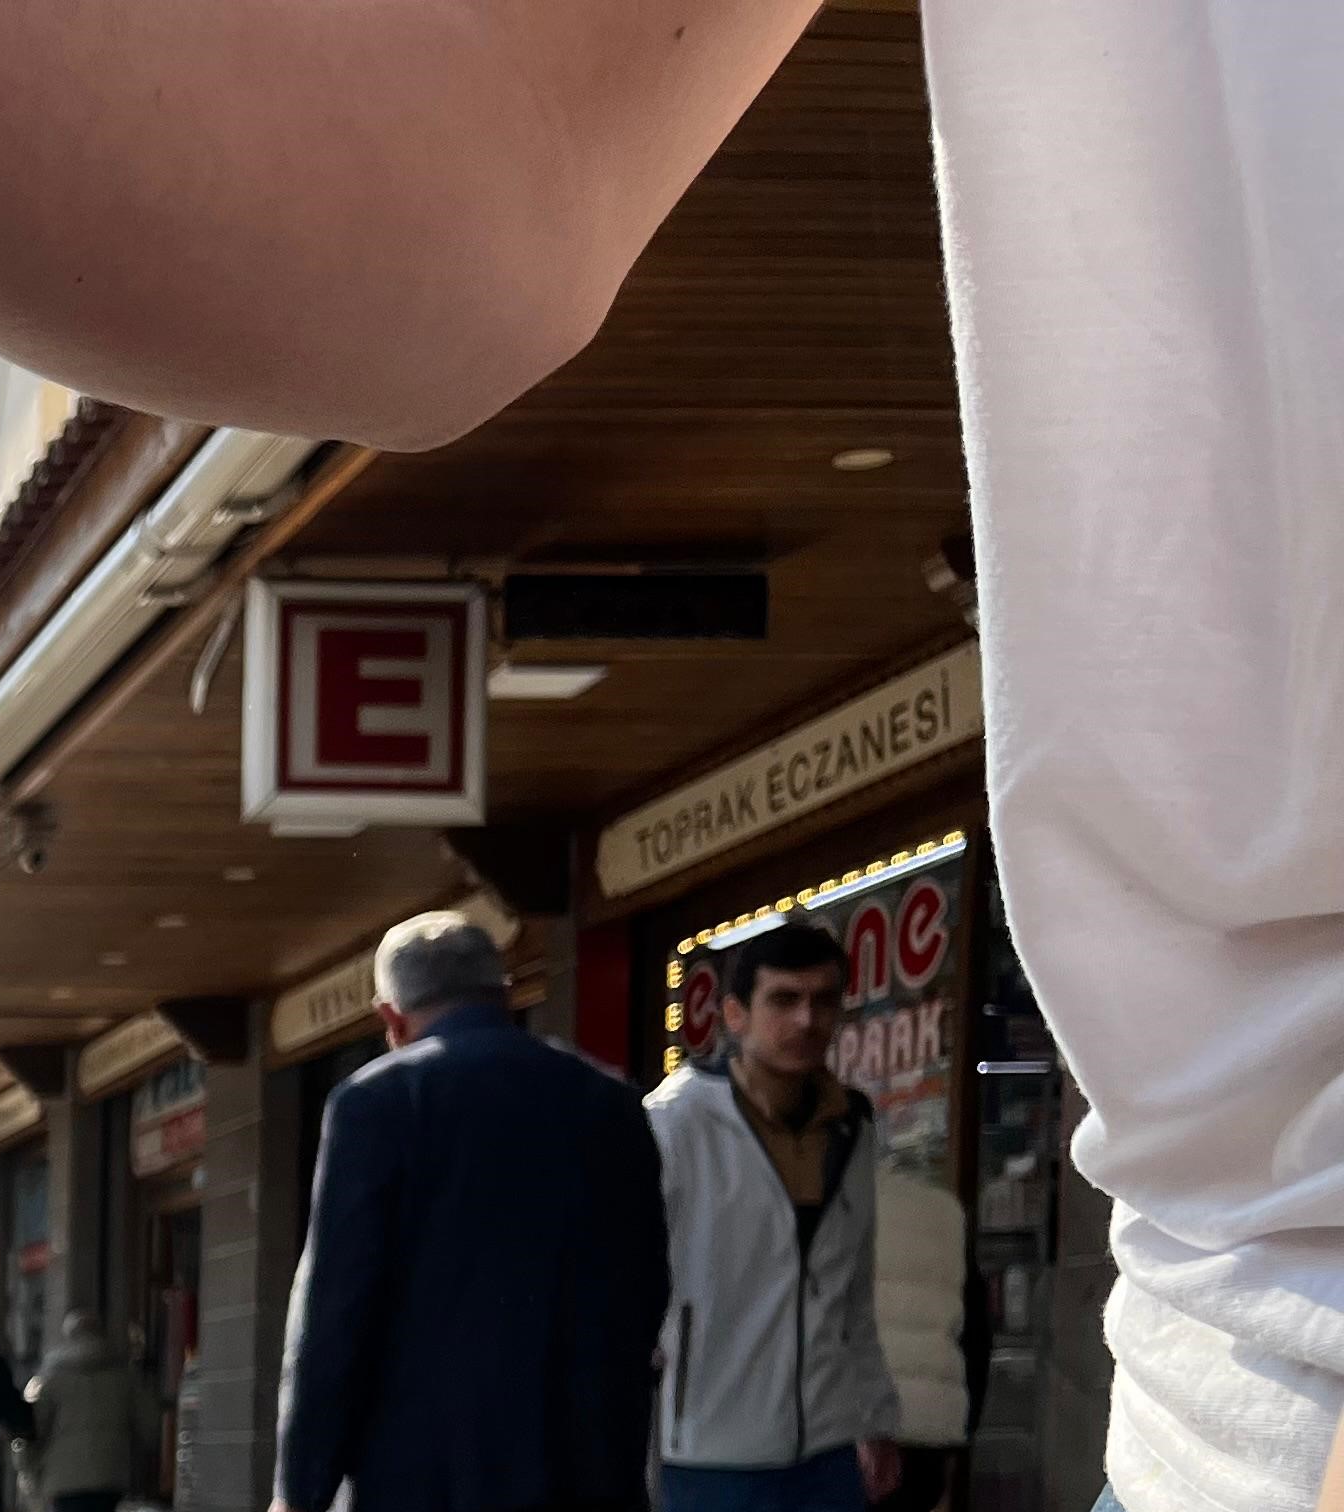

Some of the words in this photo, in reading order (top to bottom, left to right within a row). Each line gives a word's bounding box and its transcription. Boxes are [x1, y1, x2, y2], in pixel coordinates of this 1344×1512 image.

[317, 628, 430, 767] E
[634, 777, 758, 873] TOPRAK
[765, 667, 952, 816] ECZANESİ
